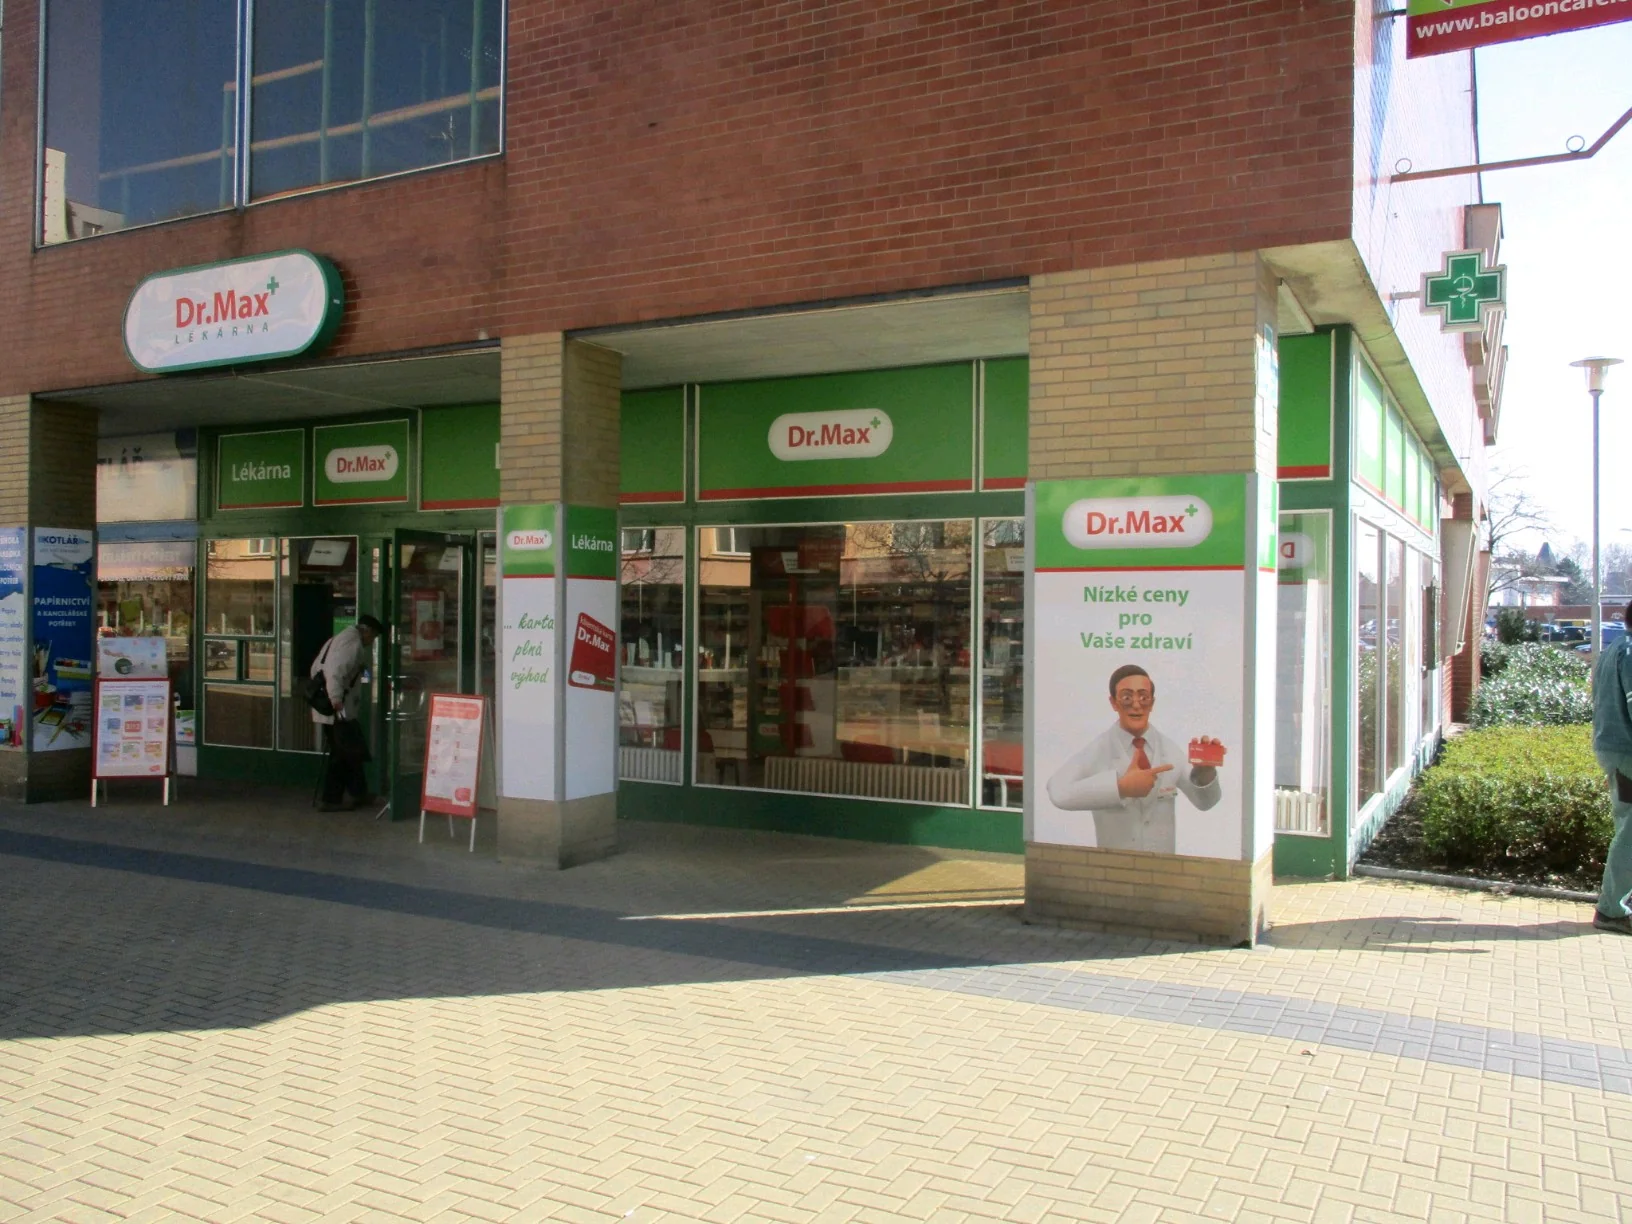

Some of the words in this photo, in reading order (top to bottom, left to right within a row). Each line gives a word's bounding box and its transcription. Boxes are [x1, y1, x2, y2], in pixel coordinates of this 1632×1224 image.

[175, 289, 269, 329] Dr.Max
[175, 322, 269, 344] LÉKÁRNA
[788, 423, 871, 448] Dr.Max
[231, 462, 291, 482] Lékárna
[336, 456, 386, 473] Dr.Max
[1086, 510, 1185, 535] Dr.Max
[513, 535, 545, 546] Dr.Max
[571, 534, 614, 552] Lékárna
[34, 595, 90, 606] PAPÍRNICTVÍ
[1083, 585, 1137, 603] Nízké
[1143, 589, 1189, 607] ceny
[518, 613, 555, 630] karta
[1119, 612, 1153, 630] pro
[577, 627, 610, 653] Dr.Max
[1080, 632, 1125, 649] Vaše
[1130, 632, 1193, 650] zdraví
[512, 640, 543, 662] plná
[510, 668, 549, 689] výhod
